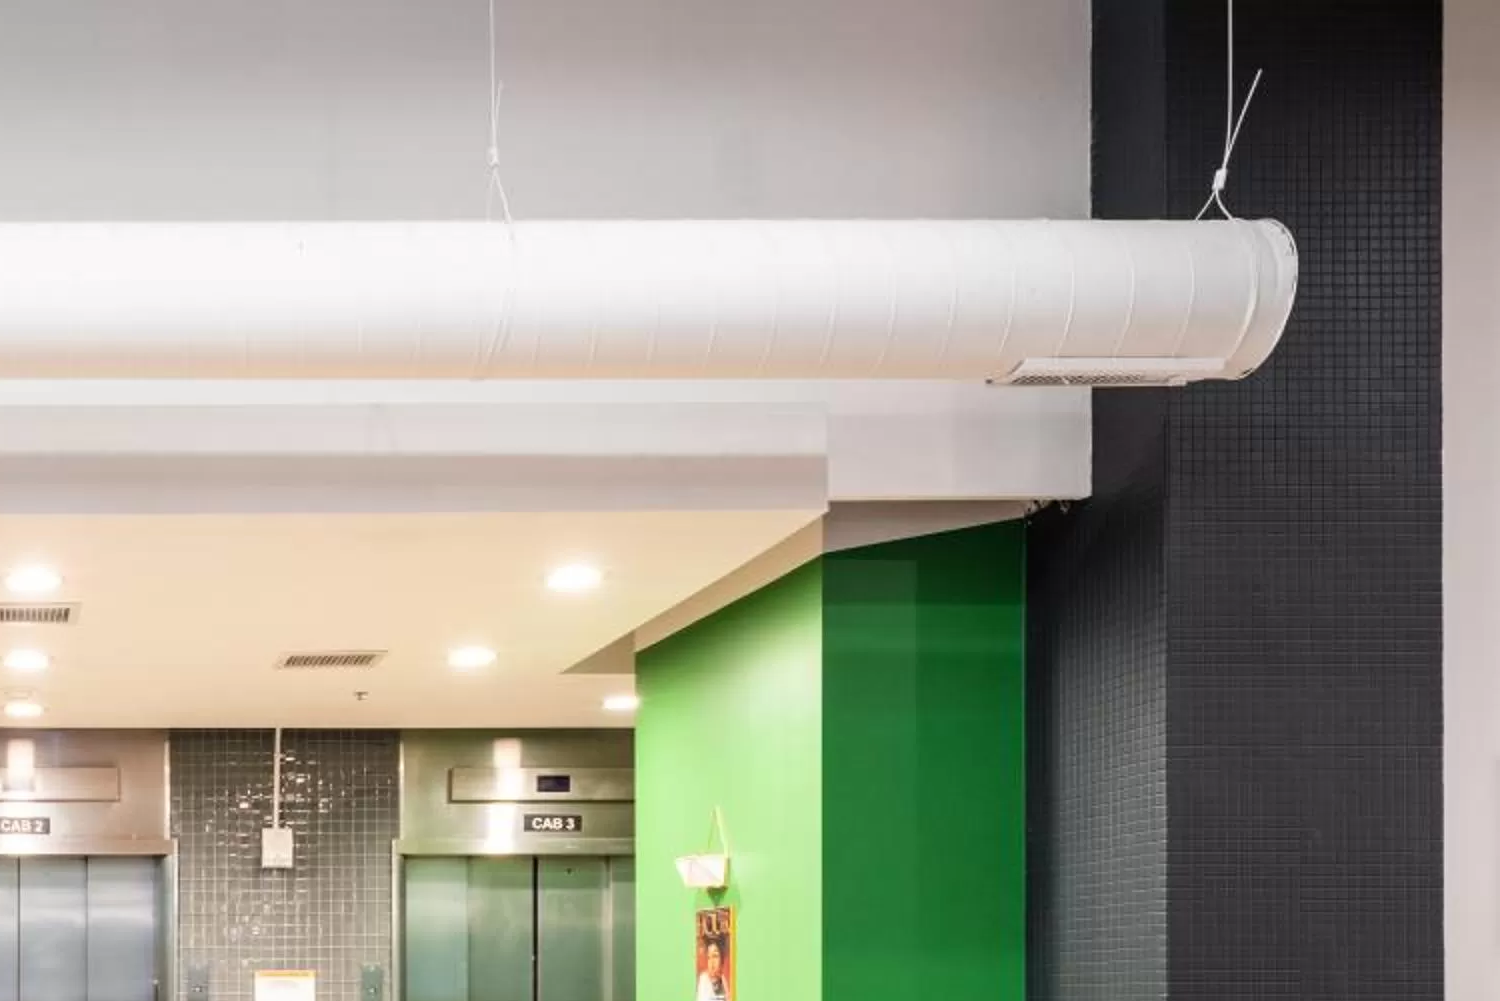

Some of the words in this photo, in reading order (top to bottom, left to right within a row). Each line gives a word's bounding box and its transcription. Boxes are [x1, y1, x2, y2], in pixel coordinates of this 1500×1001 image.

[1, 819, 32, 833] CAB
[35, 819, 44, 833] 2
[532, 817, 563, 830] CAB
[565, 817, 575, 830] 3
